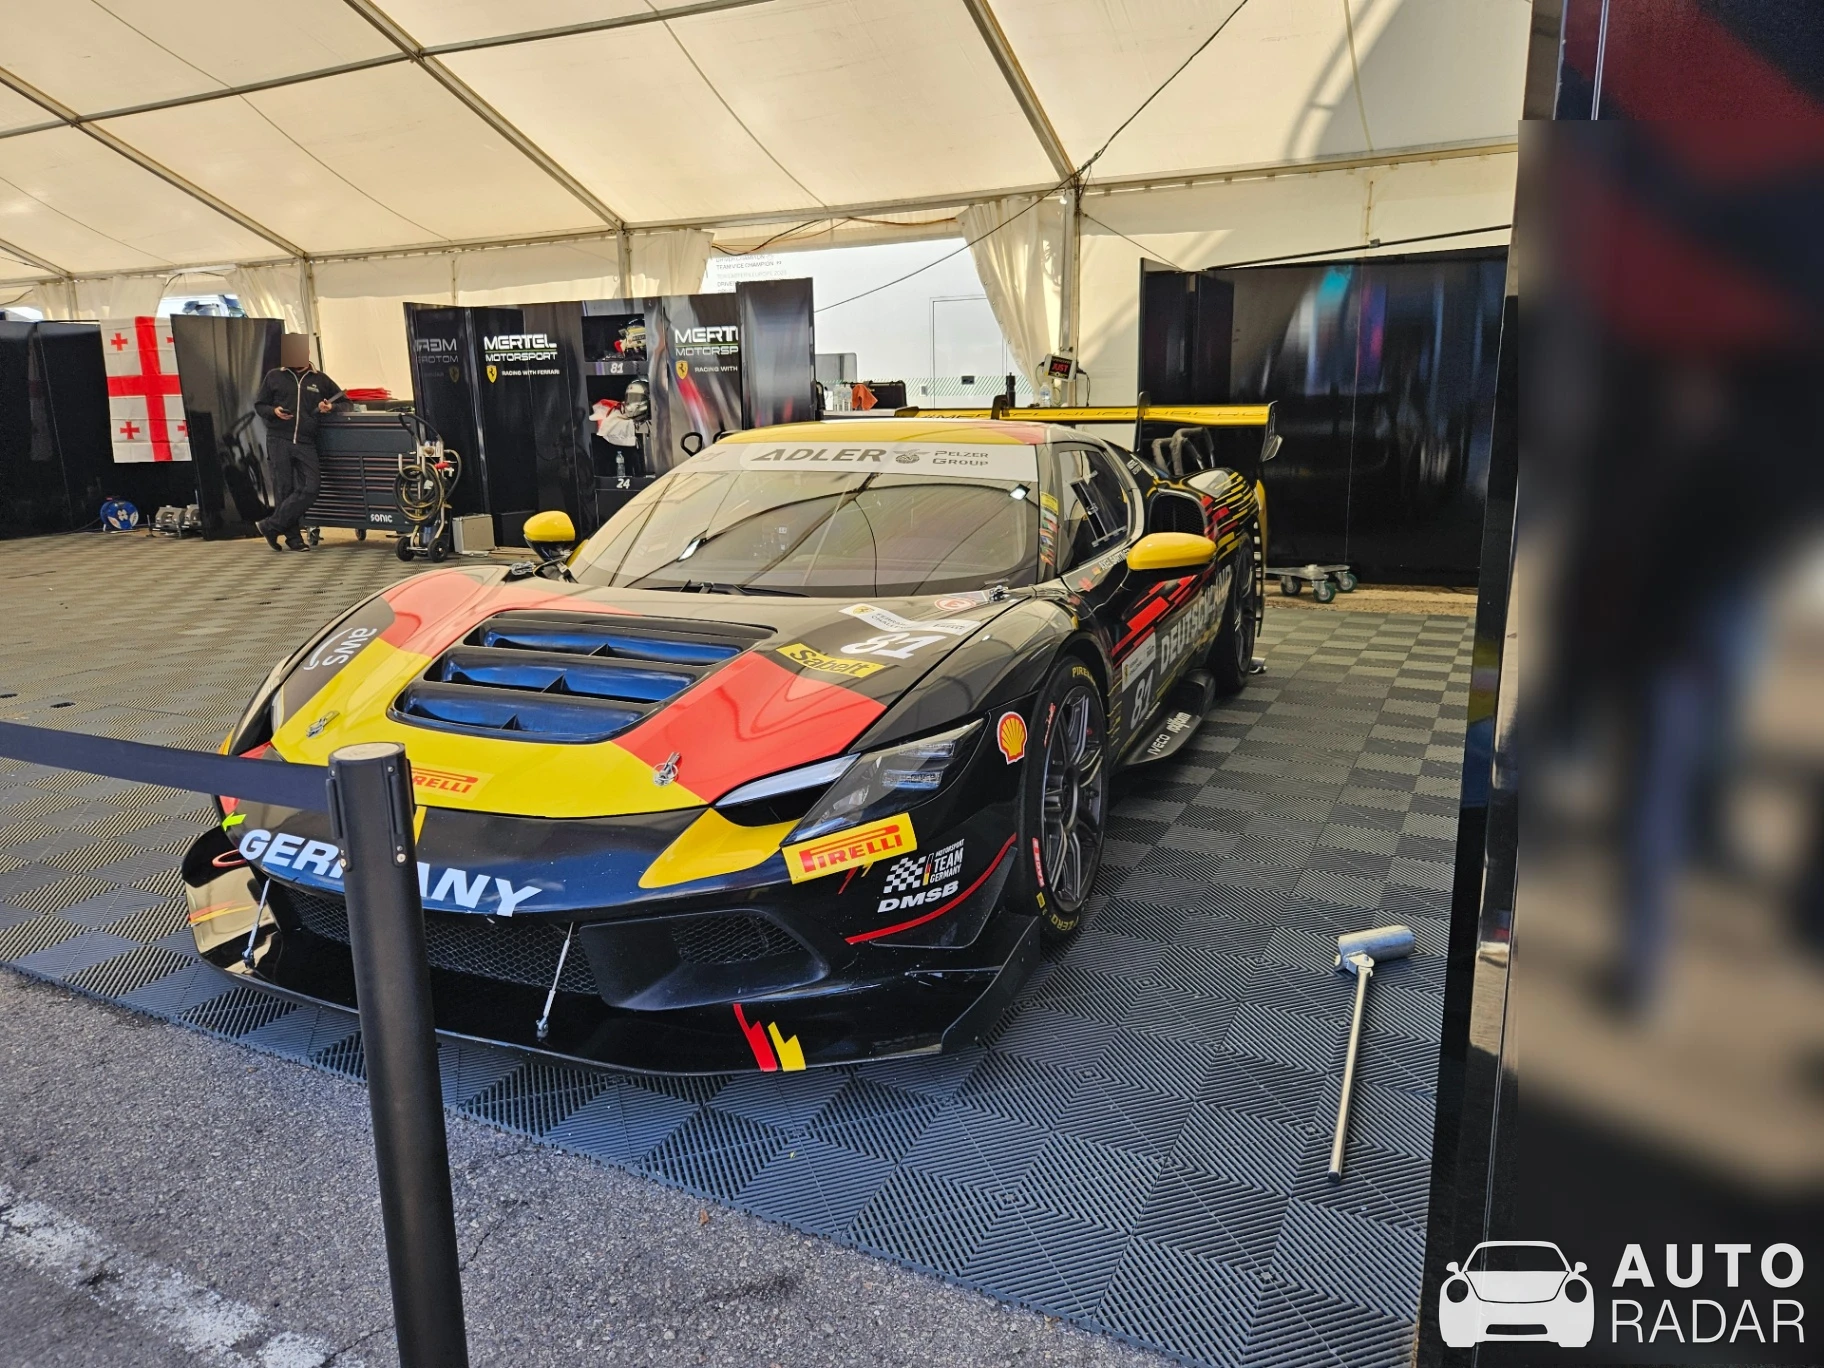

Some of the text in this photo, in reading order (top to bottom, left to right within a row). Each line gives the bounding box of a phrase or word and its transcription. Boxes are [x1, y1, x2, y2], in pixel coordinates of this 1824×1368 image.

[744, 260, 774, 268] CHAMPION
[484, 333, 557, 350] MERTEL
[485, 351, 558, 362] MOTORSPORT
[537, 368, 560, 376] FERRARI
[610, 362, 624, 374] 81
[751, 448, 887, 462] ADLER
[617, 478, 631, 489] 24
[840, 632, 948, 660] 81
[789, 649, 870, 675] Sabelt
[1130, 668, 1154, 730] 81
[1147, 733, 1171, 755] IVECO
[798, 824, 903, 874] PIRELLI
[935, 838, 965, 858] MOTORSPORT
[933, 847, 964, 874] TEAM
[929, 863, 962, 885] GERMANY
[876, 880, 960, 914] DMSB
